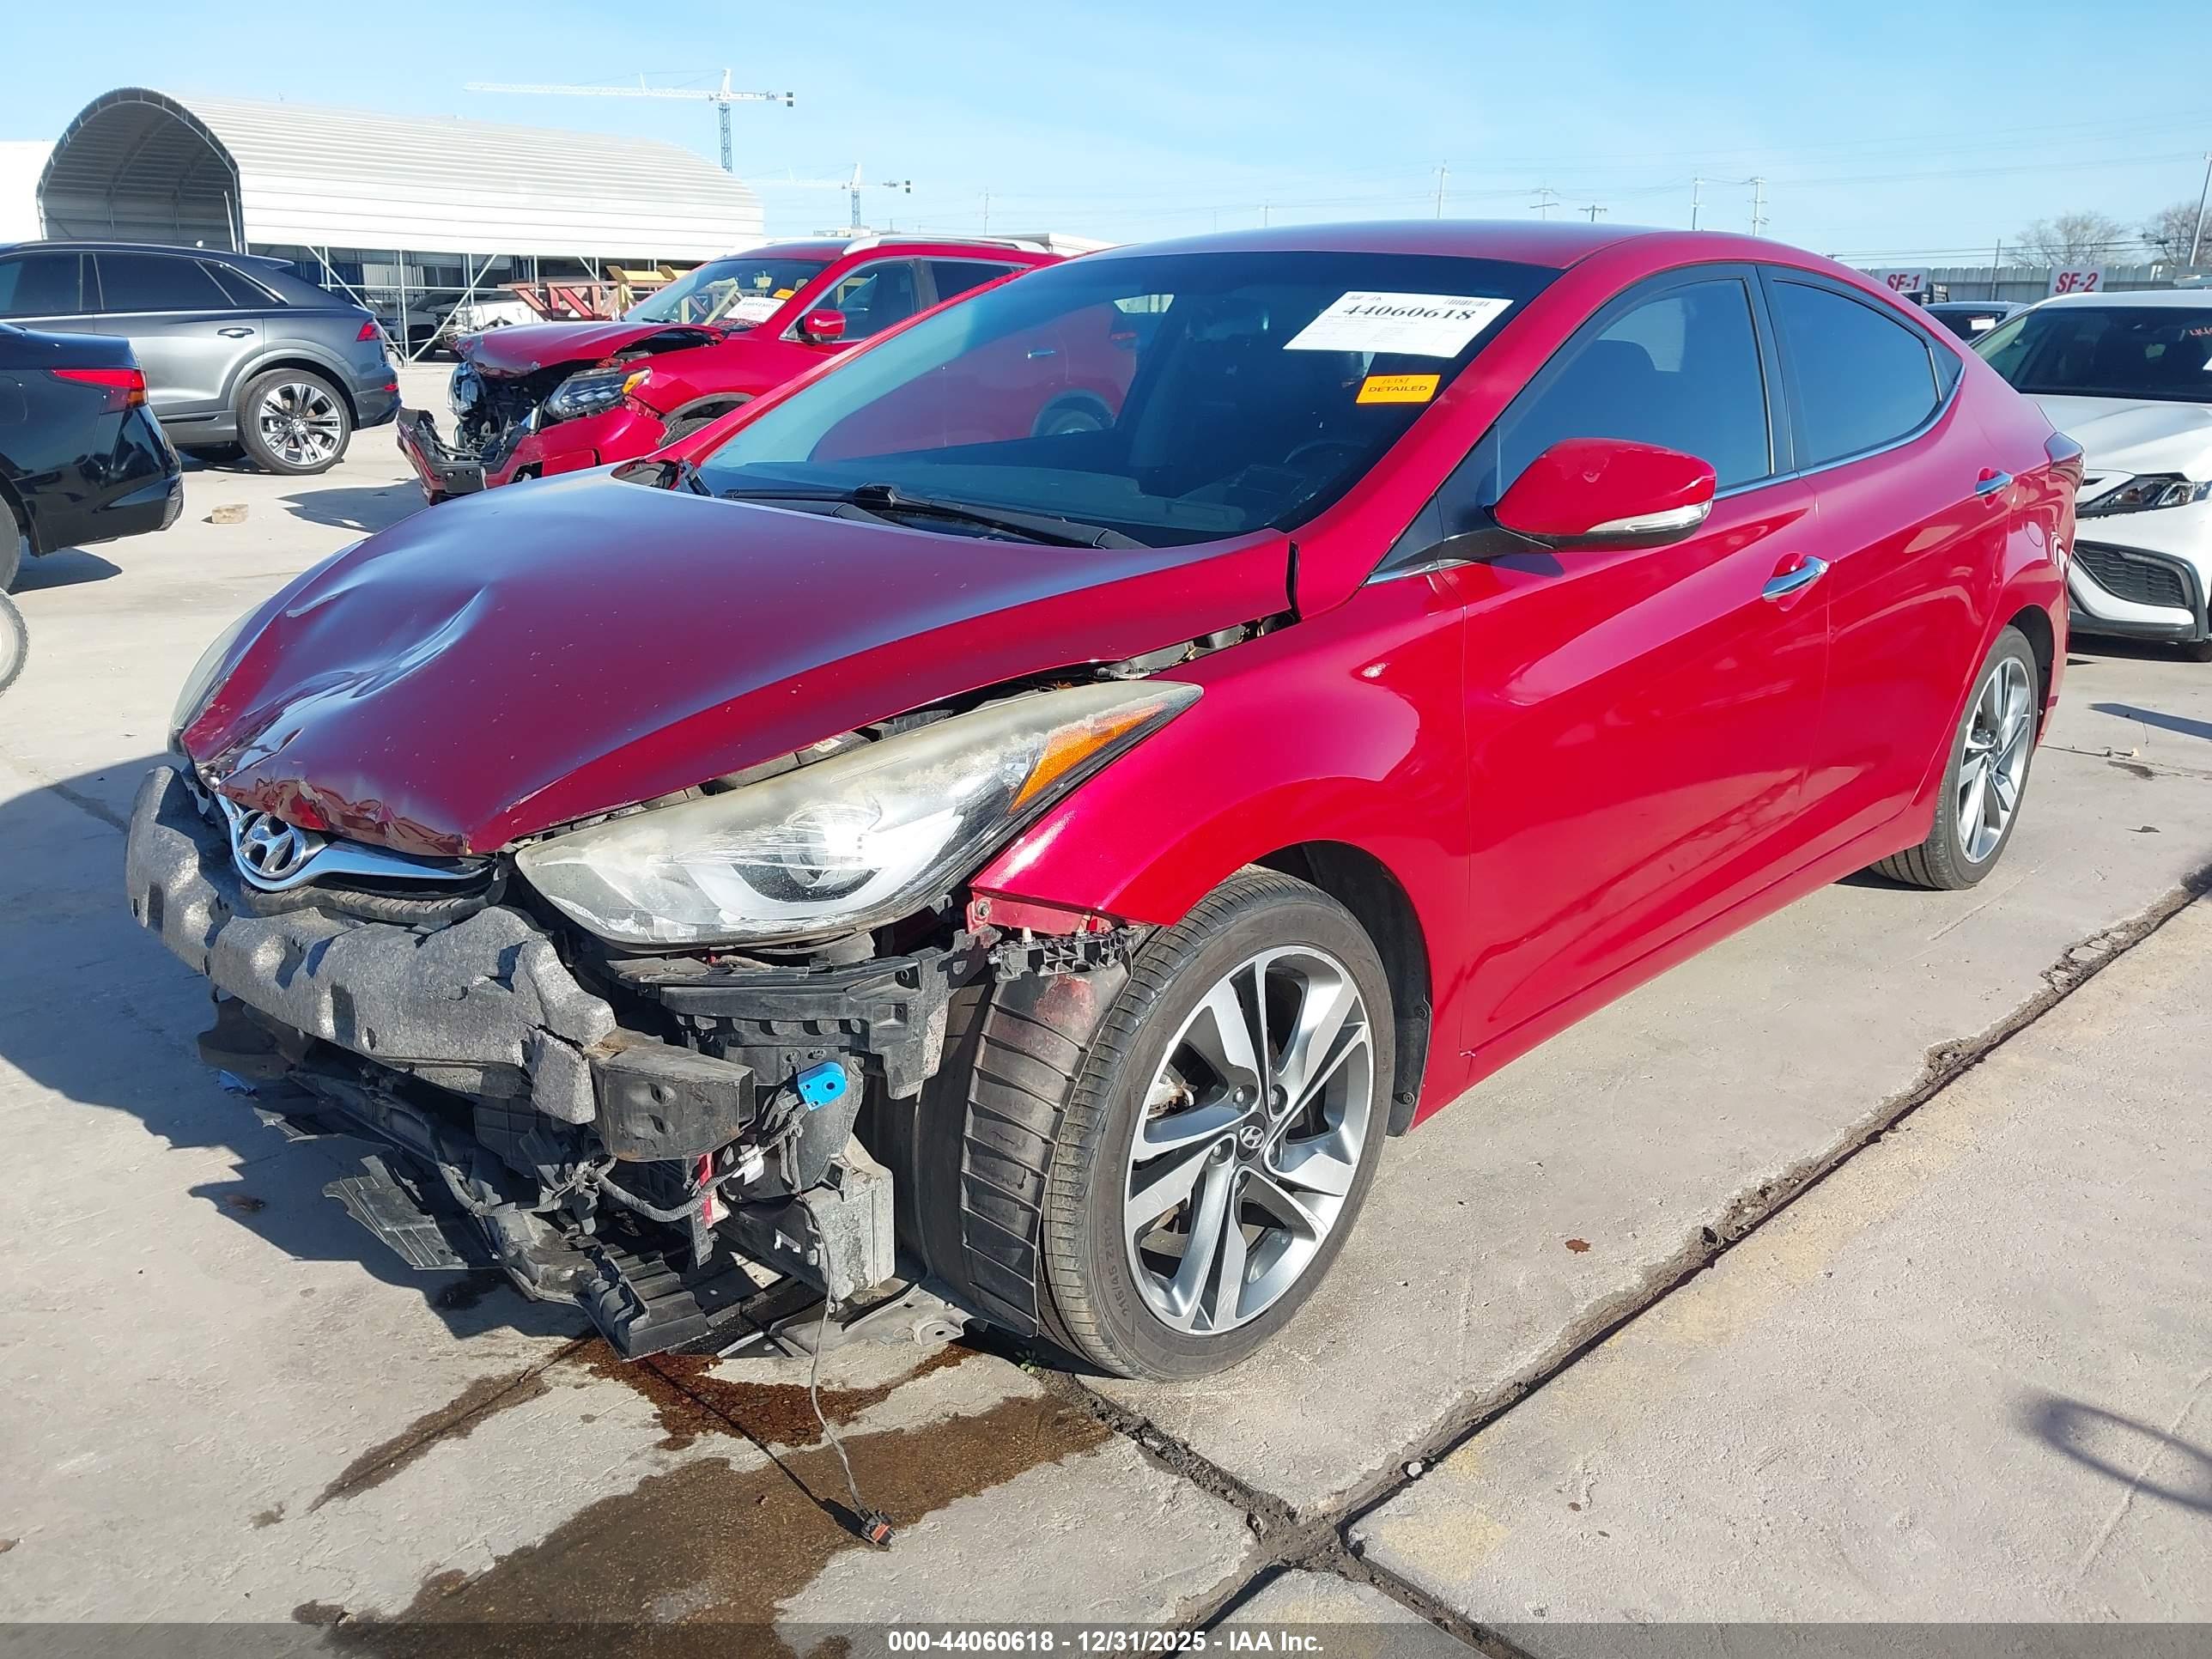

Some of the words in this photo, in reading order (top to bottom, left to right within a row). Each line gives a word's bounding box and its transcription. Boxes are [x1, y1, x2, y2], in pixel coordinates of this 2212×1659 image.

[1887, 273, 1921, 291] SF-1
[2055, 271, 2099, 294] SF-2
[1343, 304, 1477, 320] 44060618
